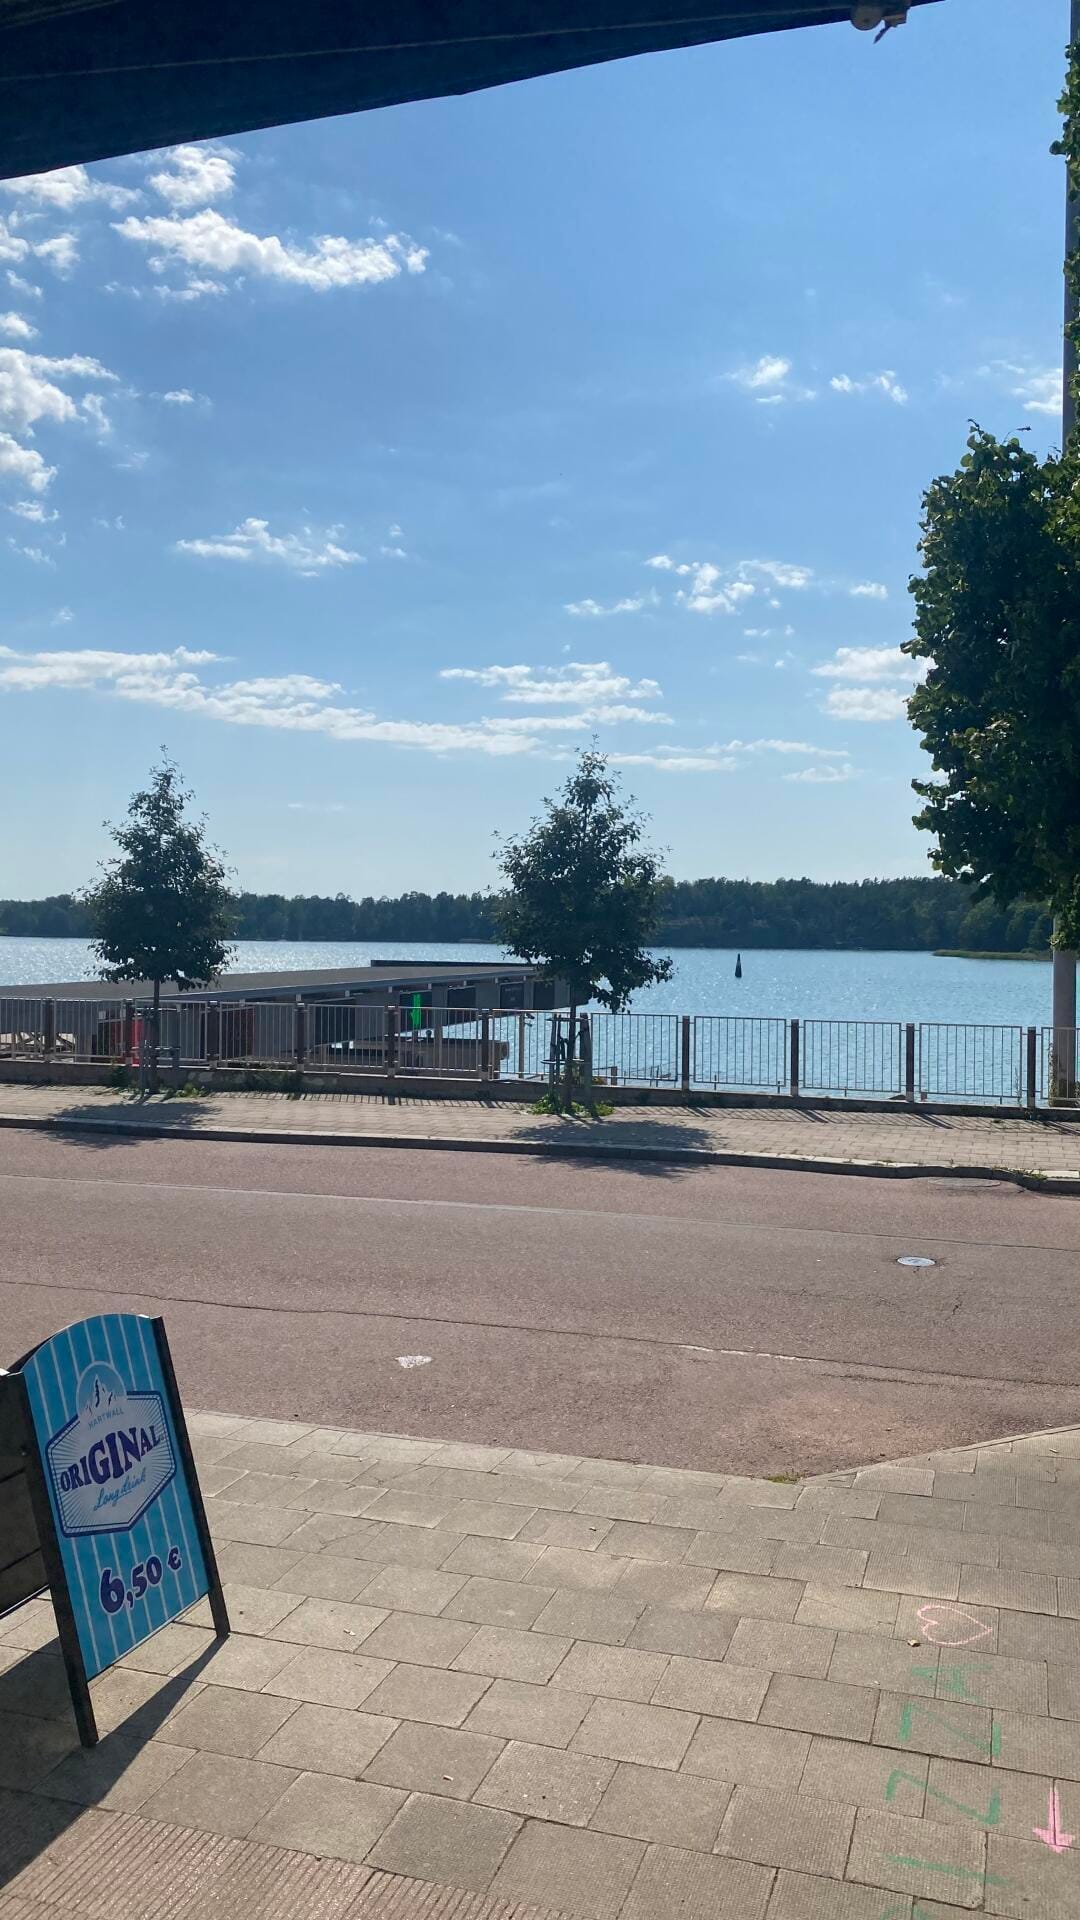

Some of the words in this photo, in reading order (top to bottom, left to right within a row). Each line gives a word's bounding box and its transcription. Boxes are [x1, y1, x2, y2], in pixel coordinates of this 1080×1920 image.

[88, 1406, 124, 1429] HARTWALL
[60, 1425, 160, 1492] ORIGINAL
[100, 1556, 162, 1614] 6,50
[167, 1546, 182, 1570] €
[882, 1662, 1009, 1920] IZZA
